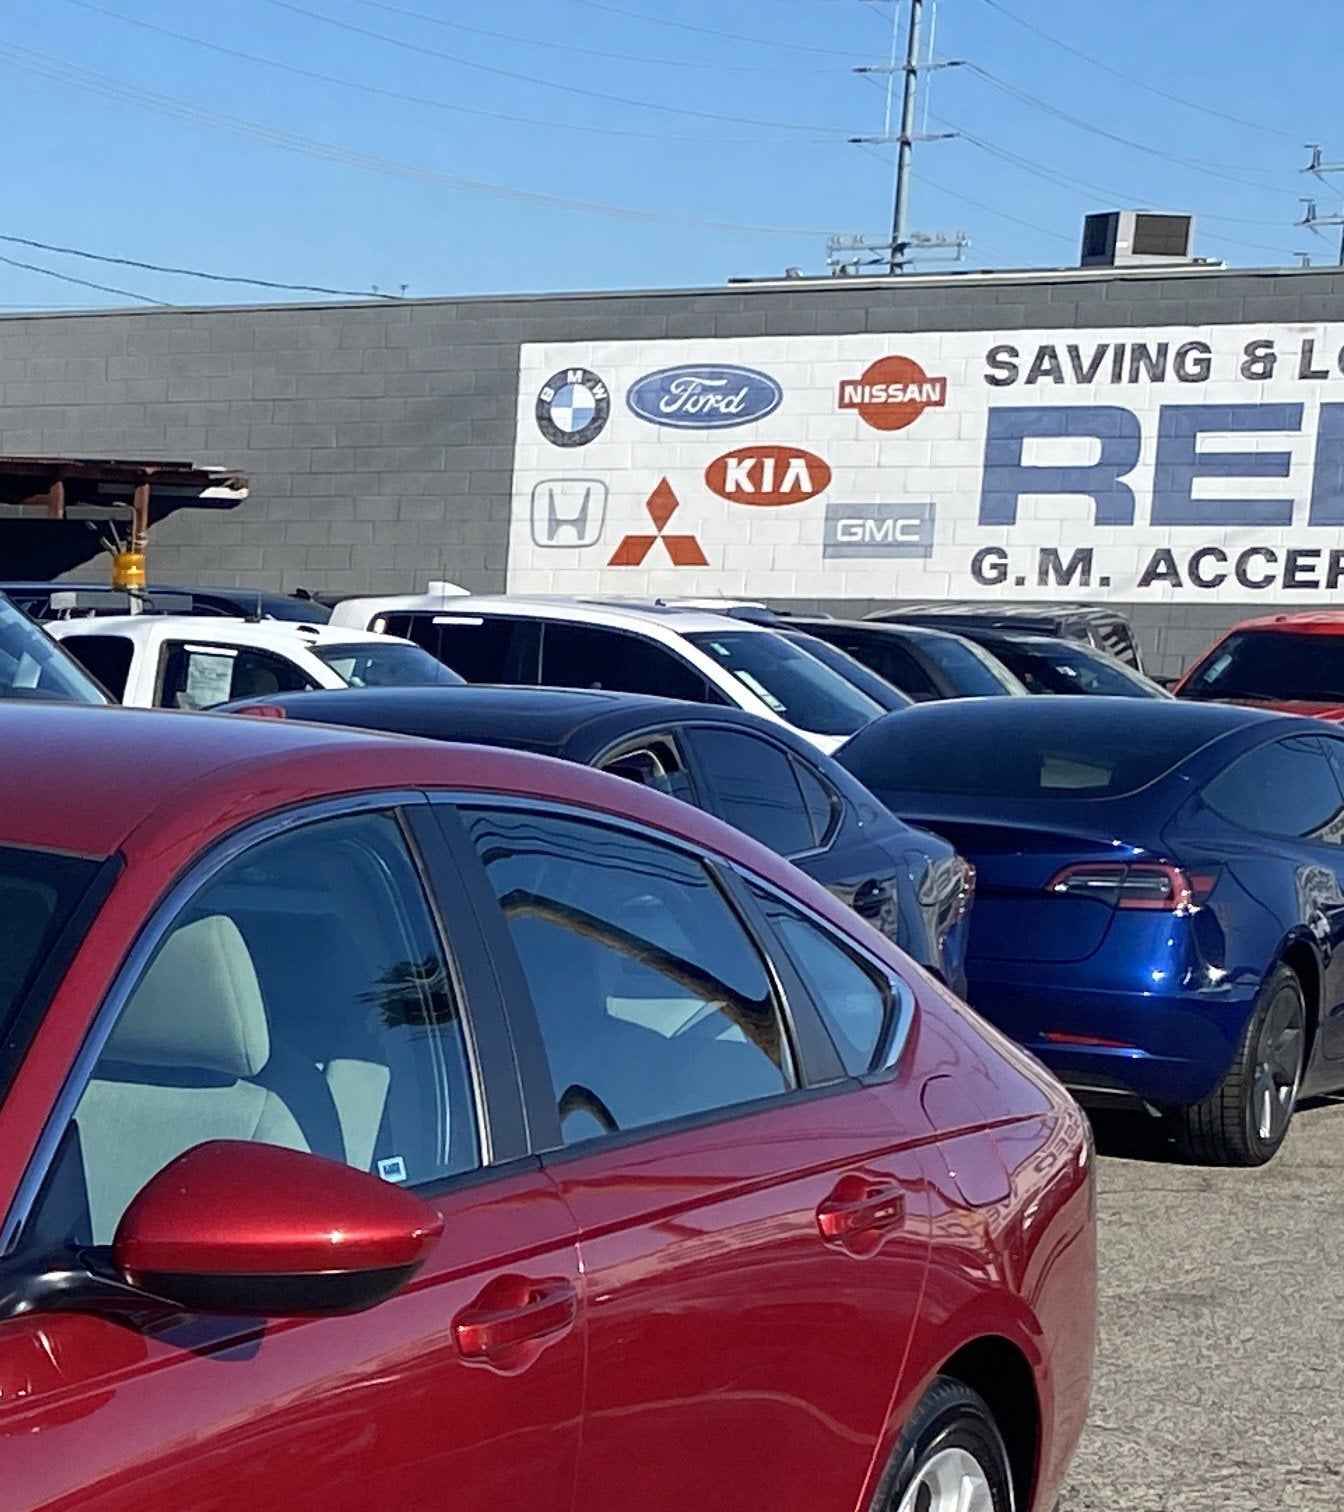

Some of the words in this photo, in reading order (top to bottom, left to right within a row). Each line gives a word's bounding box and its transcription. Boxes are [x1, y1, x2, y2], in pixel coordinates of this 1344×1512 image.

[984, 340, 1213, 387] SAVING
[1240, 339, 1278, 381] &
[1297, 337, 1344, 381] L
[539, 369, 608, 402] BMW
[659, 376, 749, 414] Ford
[843, 382, 942, 405] NISSAN
[723, 456, 813, 493] KIA
[978, 401, 1344, 527] RE
[836, 518, 922, 543] GMC
[970, 545, 1111, 587] G.M.
